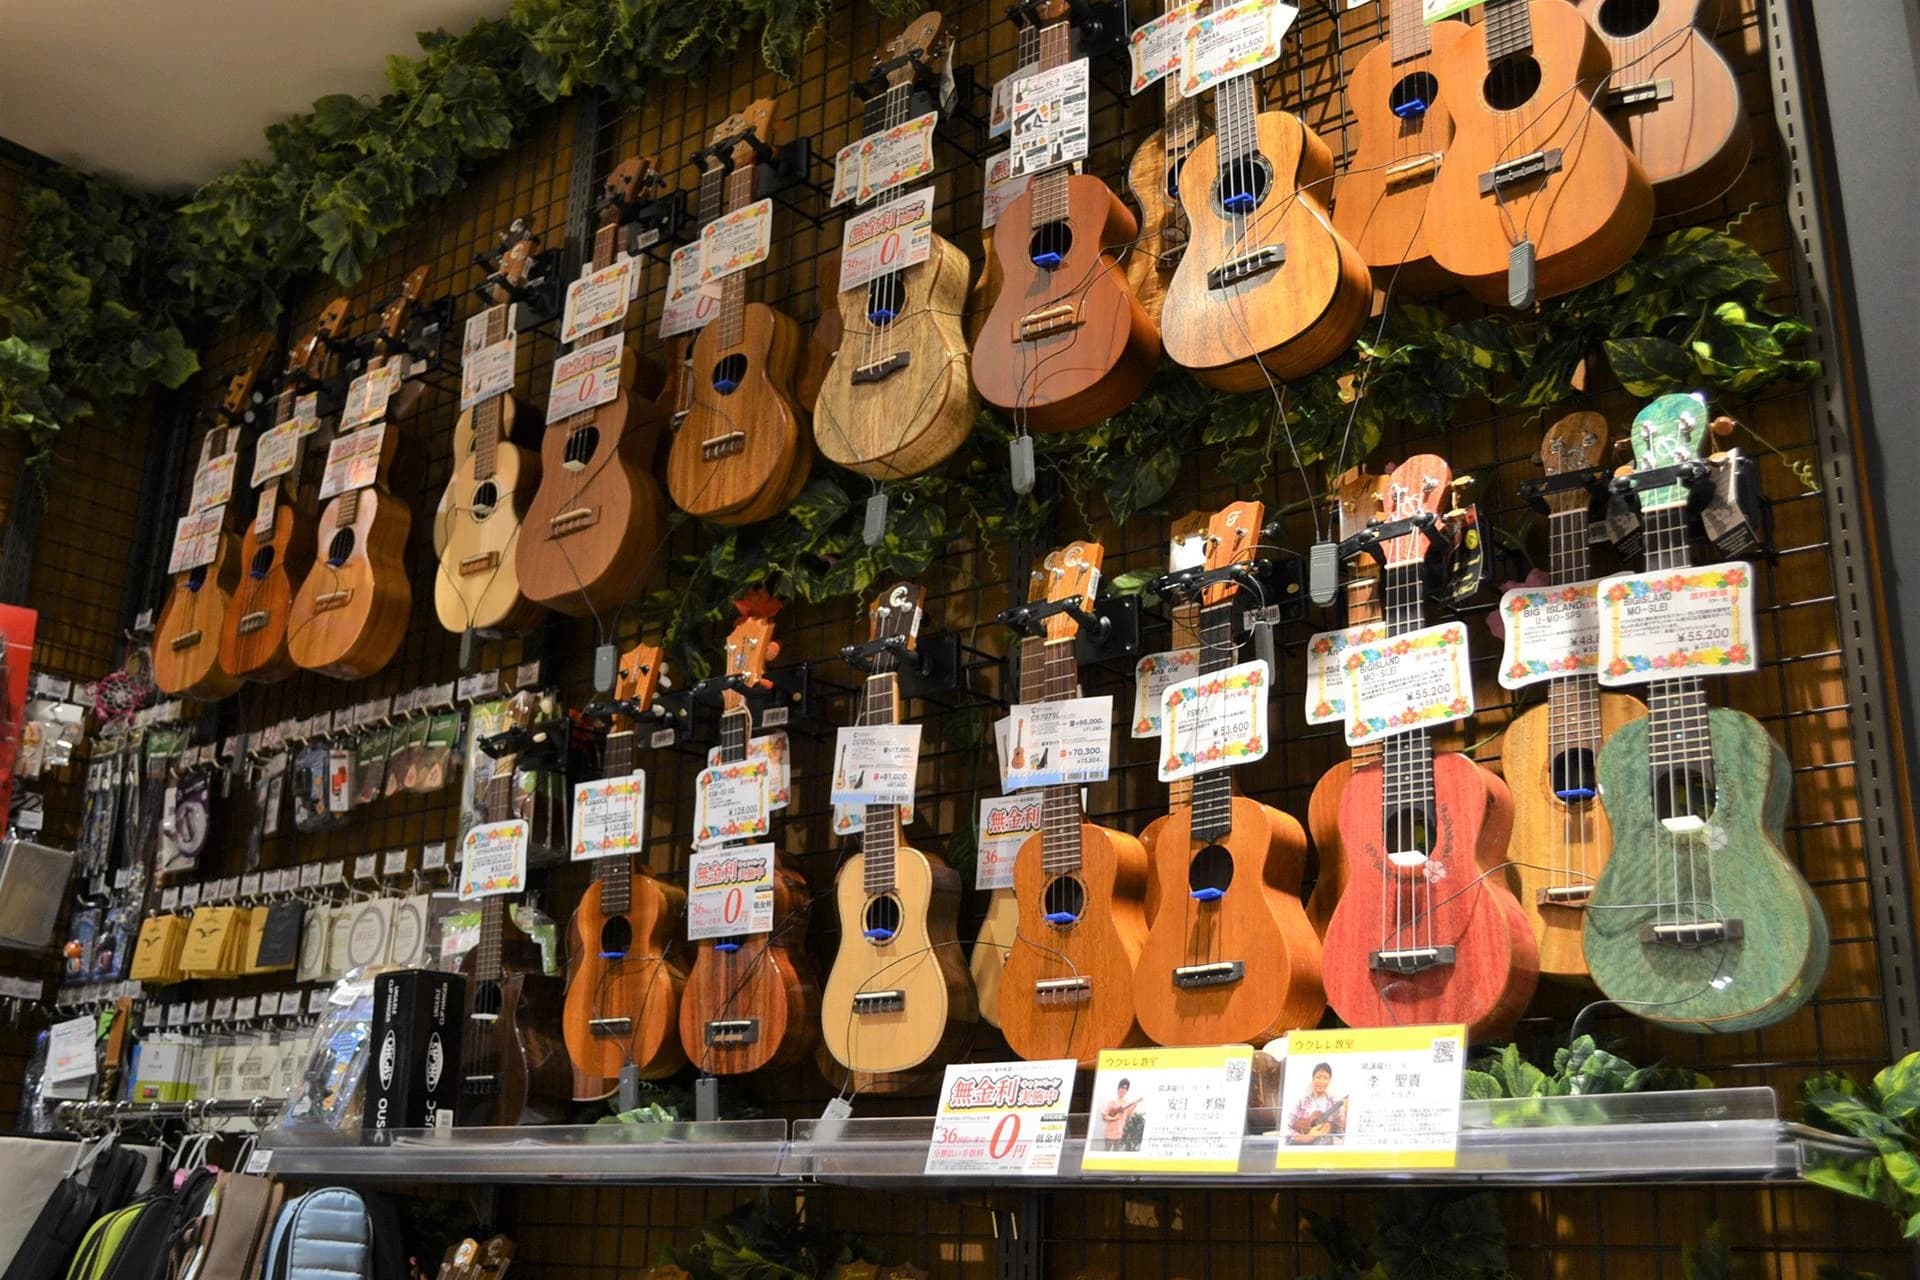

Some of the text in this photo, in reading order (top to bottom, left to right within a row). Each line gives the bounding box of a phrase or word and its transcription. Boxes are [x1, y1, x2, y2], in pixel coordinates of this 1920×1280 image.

[1523, 601, 1583, 618] BIG ISLAND
[1294, 1039, 1355, 1051] ウクレレ教室
[1105, 1057, 1158, 1067] ウクレレ教室
[950, 1078, 1019, 1107] 無金利
[1034, 1133, 1063, 1144] 低金利
